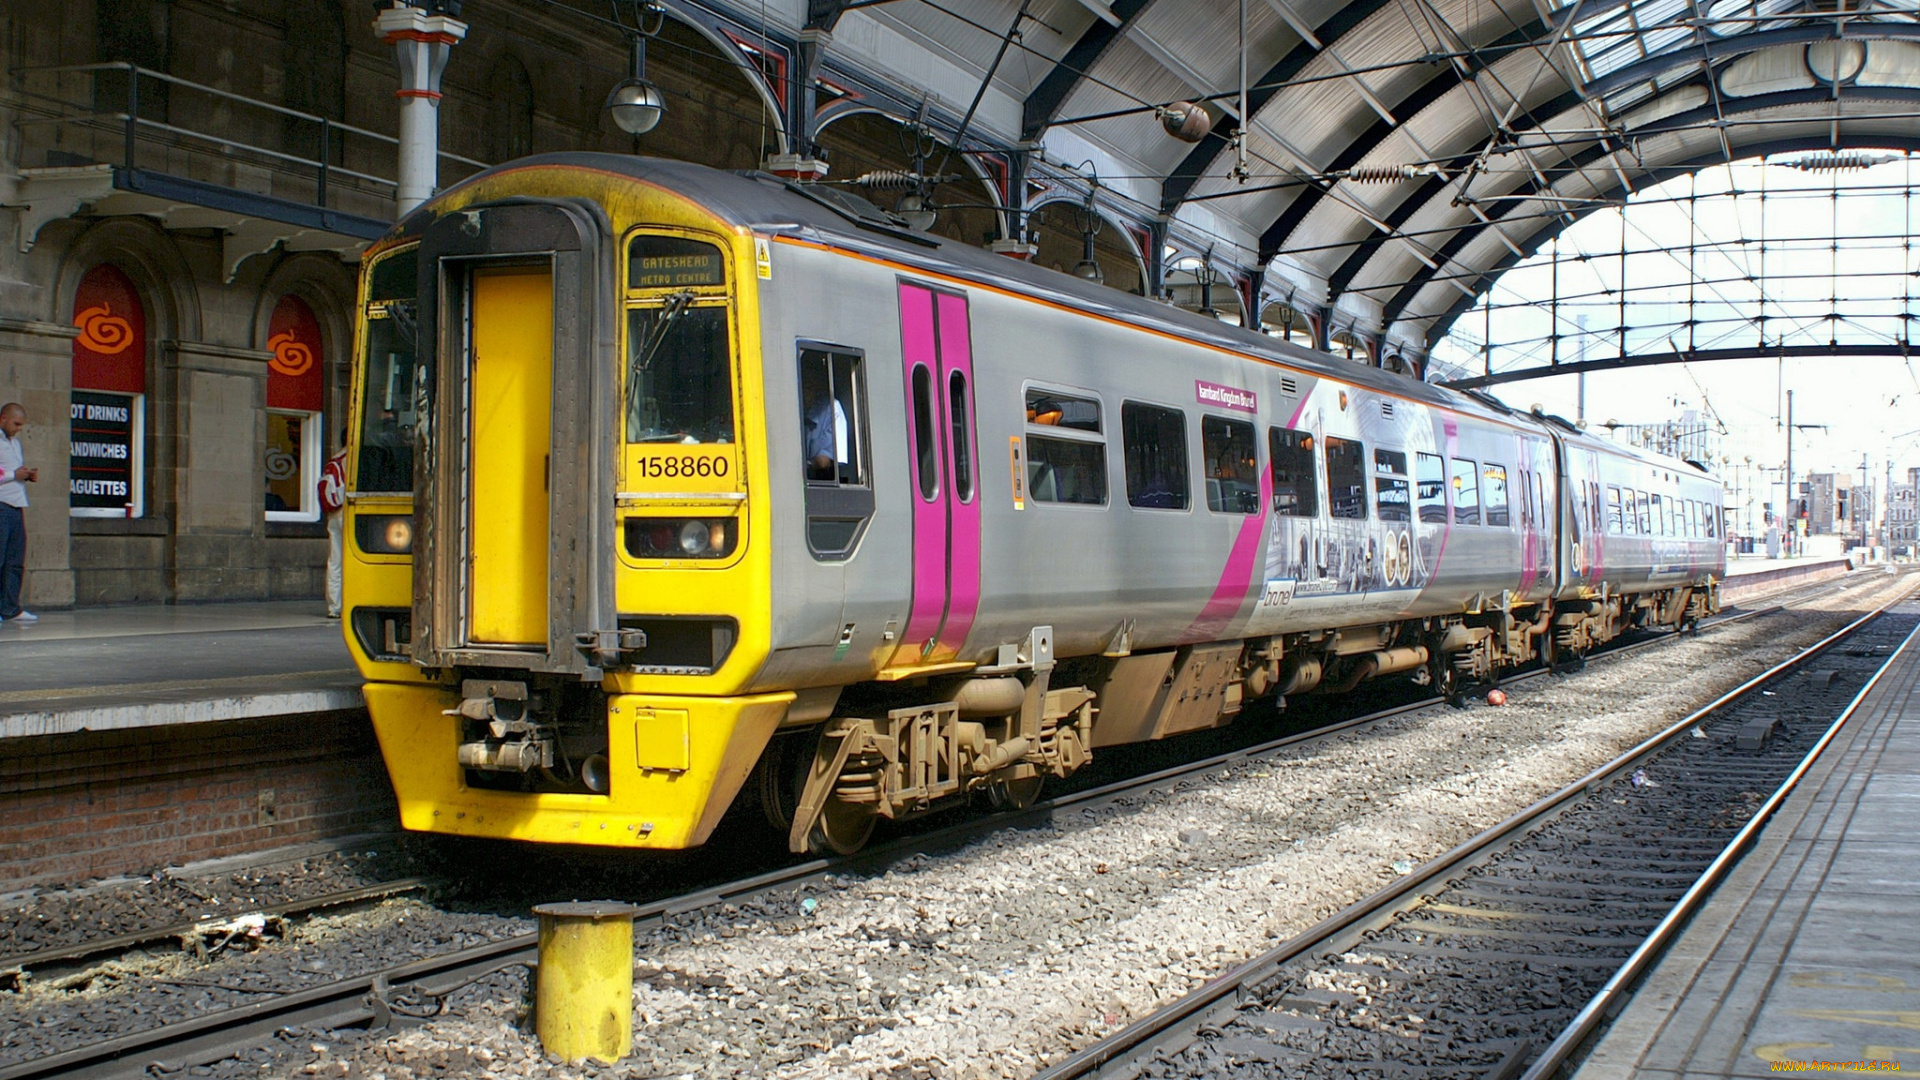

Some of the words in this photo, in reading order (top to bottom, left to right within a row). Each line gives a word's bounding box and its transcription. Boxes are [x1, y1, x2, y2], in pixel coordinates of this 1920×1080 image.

[642, 255, 709, 269] GATESHEAD
[641, 274, 671, 284] METRO
[676, 273, 712, 284] CENTRE
[70, 403, 86, 419] OT
[87, 404, 128, 422] DRINKS
[70, 441, 127, 459] ANDWICHES
[637, 456, 728, 478] 158860
[70, 478, 127, 496] AGUETTES
[1264, 584, 1294, 606] brunel
